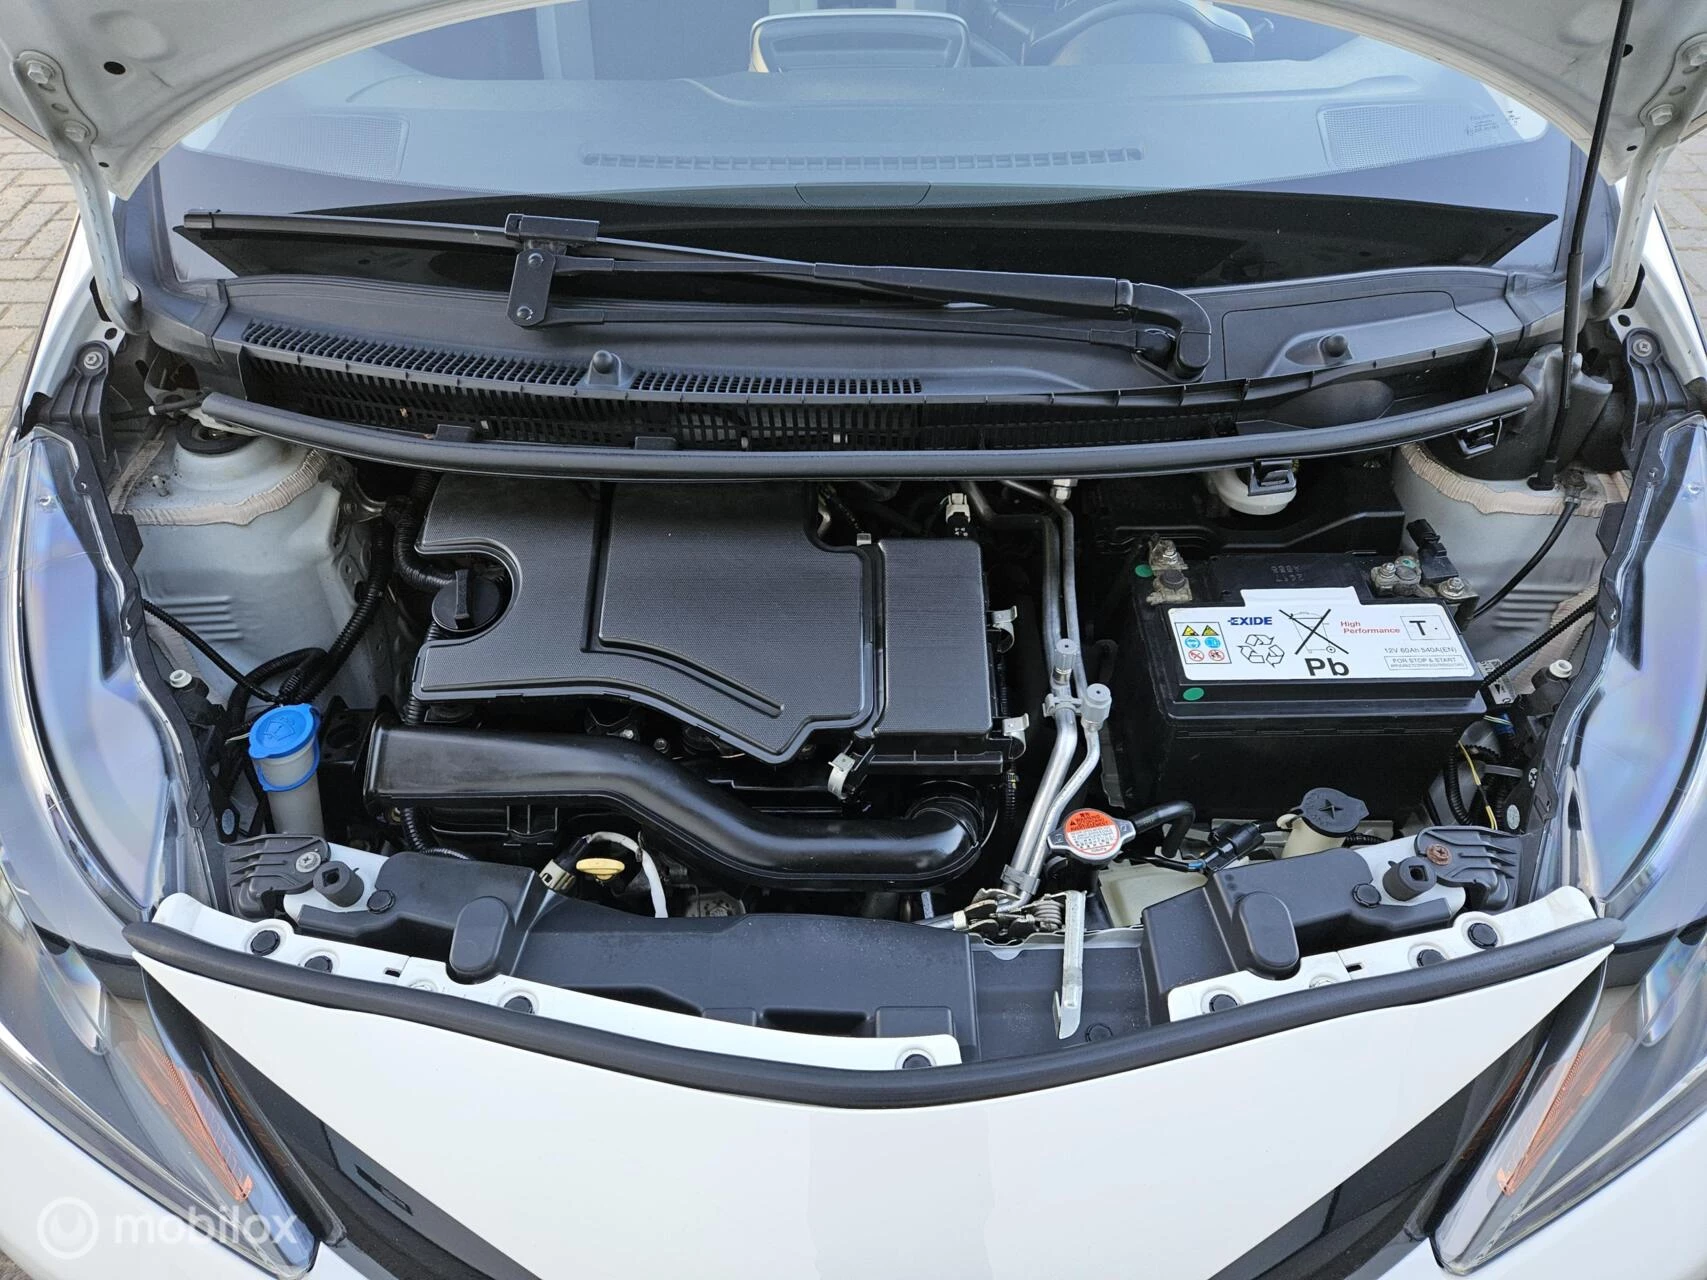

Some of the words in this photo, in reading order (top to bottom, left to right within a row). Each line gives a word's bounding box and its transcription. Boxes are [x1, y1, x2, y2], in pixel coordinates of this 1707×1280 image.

[1228, 617, 1272, 625] EXIDE
[1343, 627, 1401, 635] Performance
[1409, 620, 1427, 636] T
[1305, 657, 1350, 676] Pb
